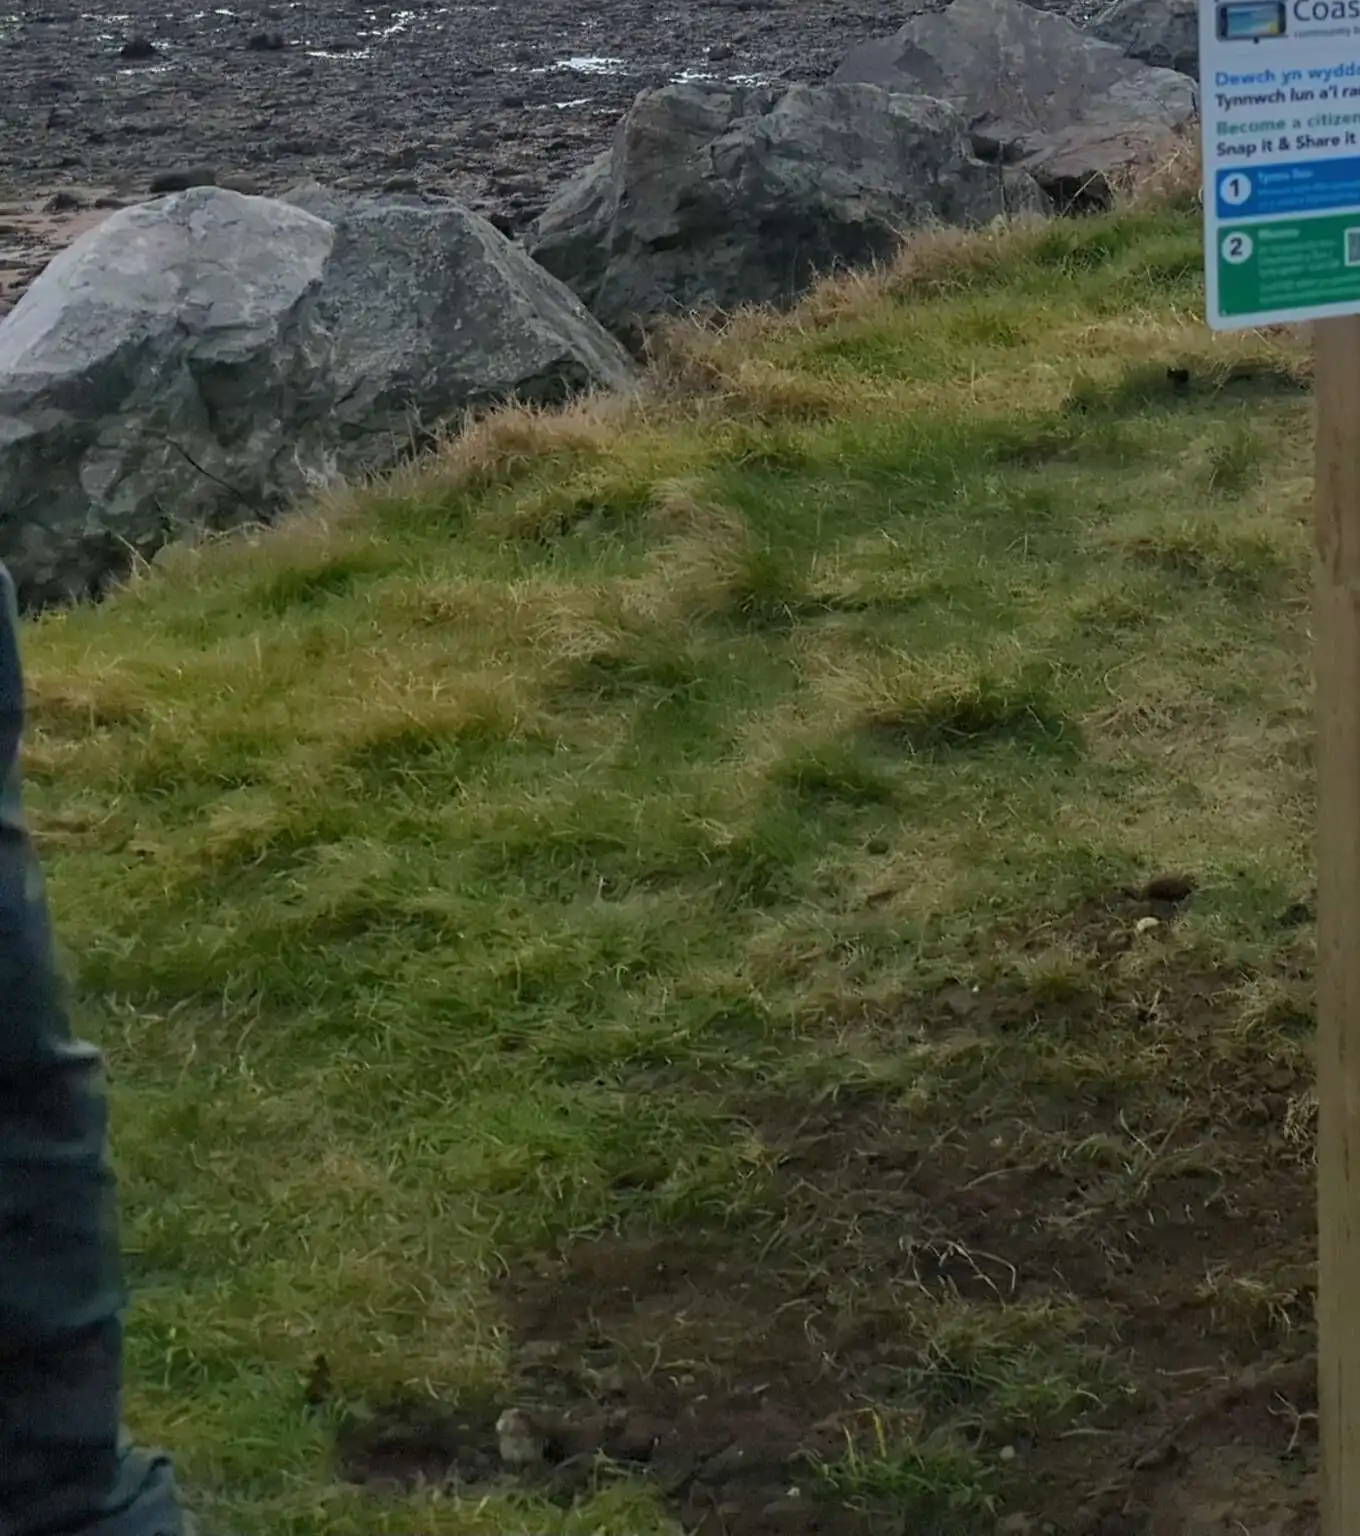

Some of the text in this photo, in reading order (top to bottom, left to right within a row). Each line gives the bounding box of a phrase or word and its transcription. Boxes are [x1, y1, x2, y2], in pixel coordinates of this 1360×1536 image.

[1215, 69, 1276, 87] Dewch
[1281, 69, 1302, 88] yn
[1214, 88, 1286, 112] Tynnwch
[1290, 87, 1315, 102] lun
[1216, 119, 1286, 136] Become
[1292, 118, 1302, 129] a
[1216, 130, 1356, 159] Snap it & Share it
[1229, 177, 1239, 198] 1
[1230, 237, 1243, 256] 2
